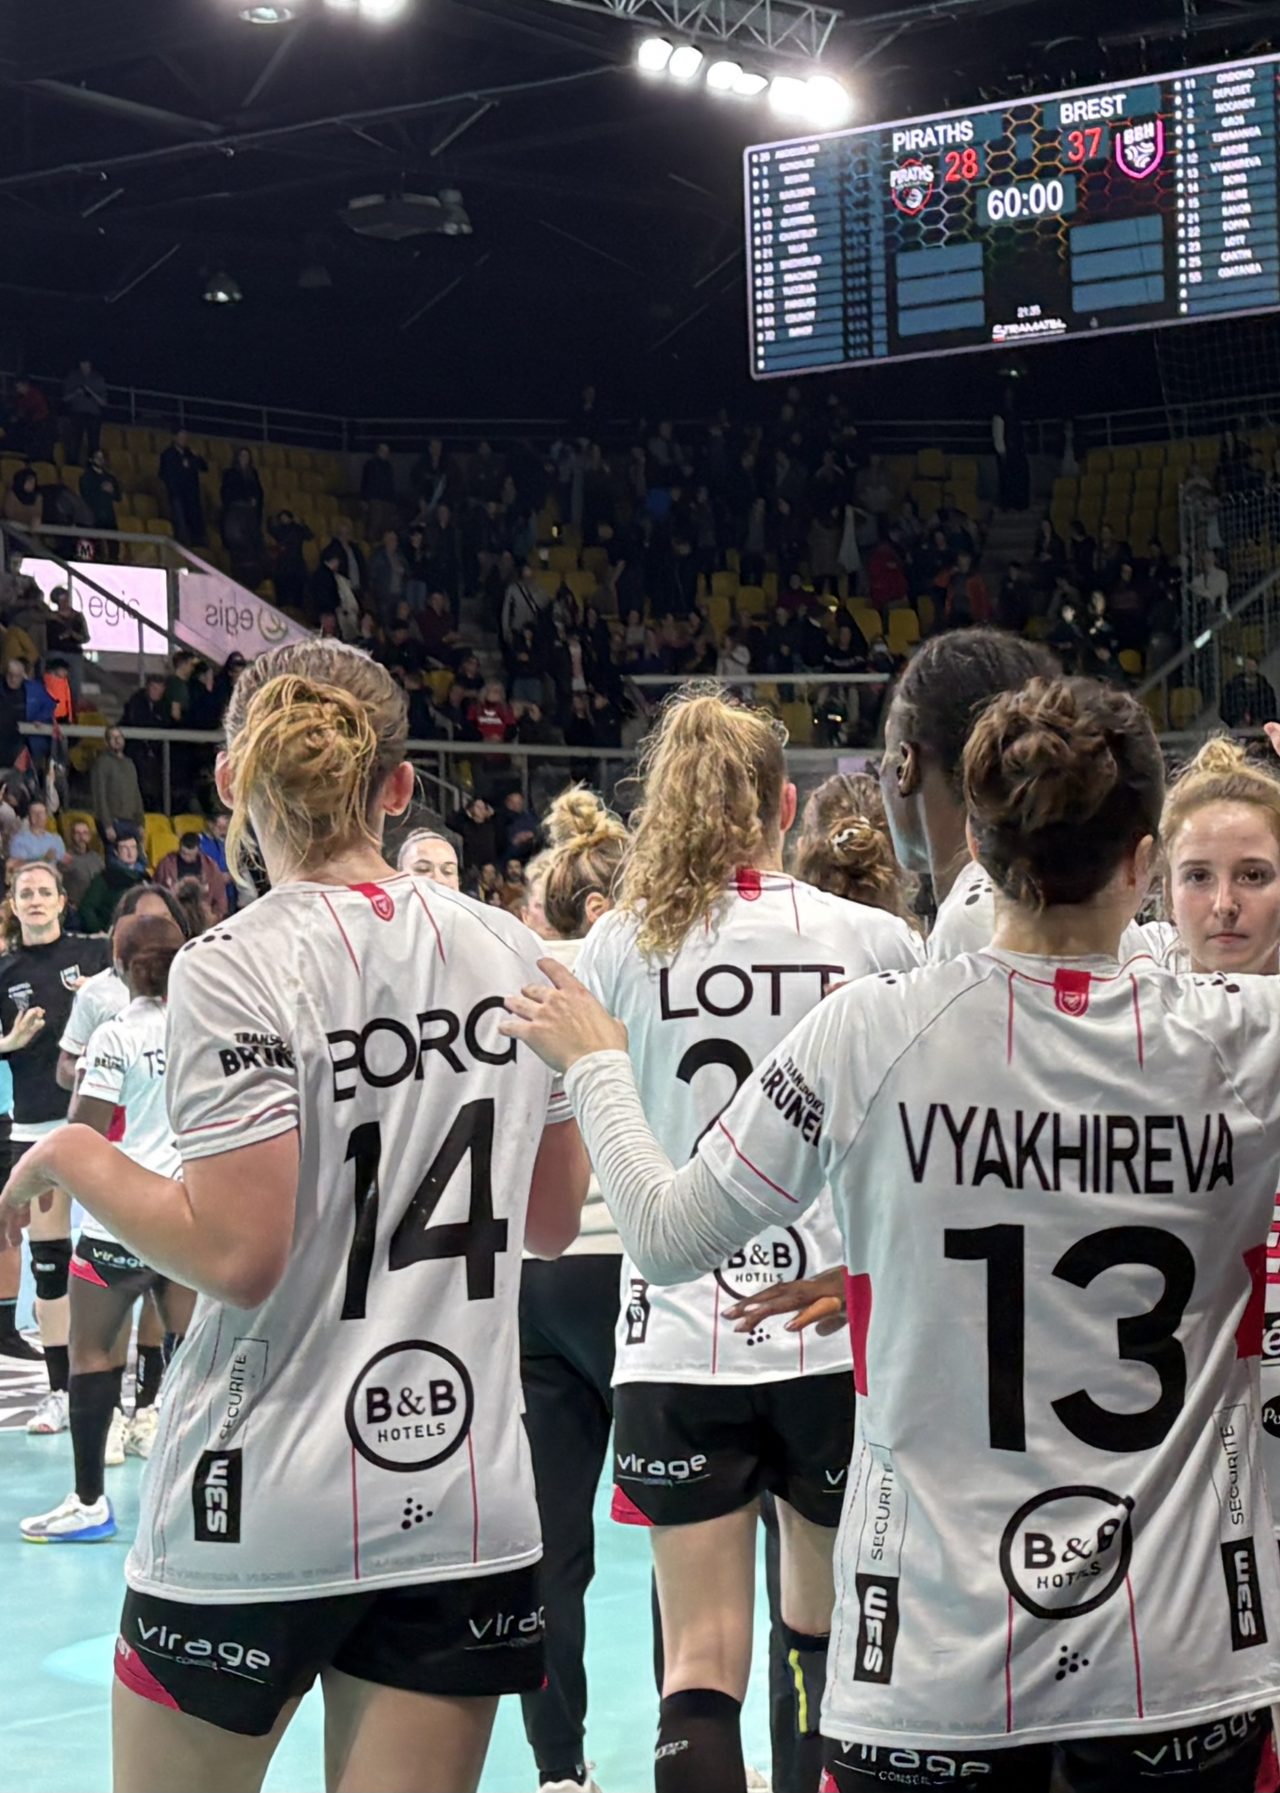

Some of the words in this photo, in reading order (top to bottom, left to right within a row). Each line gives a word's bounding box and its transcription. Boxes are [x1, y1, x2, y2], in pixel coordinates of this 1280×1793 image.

[1060, 94, 1127, 124] BREST
[893, 121, 973, 151] PIRATHS
[1067, 127, 1102, 162] 37
[1124, 122, 1154, 144] BBH
[944, 148, 979, 182] 28
[987, 180, 1064, 221] 60:00
[660, 964, 845, 1021] LOTT
[326, 995, 517, 1102] BORG
[898, 1102, 1235, 1194] VYAKHIREVA
[339, 1098, 509, 1320] 14
[735, 1273, 784, 1284] HOTELS
[944, 1223, 1196, 1453] 13
[366, 1379, 457, 1424] B&B
[377, 1422, 446, 1443] HOTELS
[617, 1453, 708, 1479] virage
[138, 1617, 271, 1670] virage
